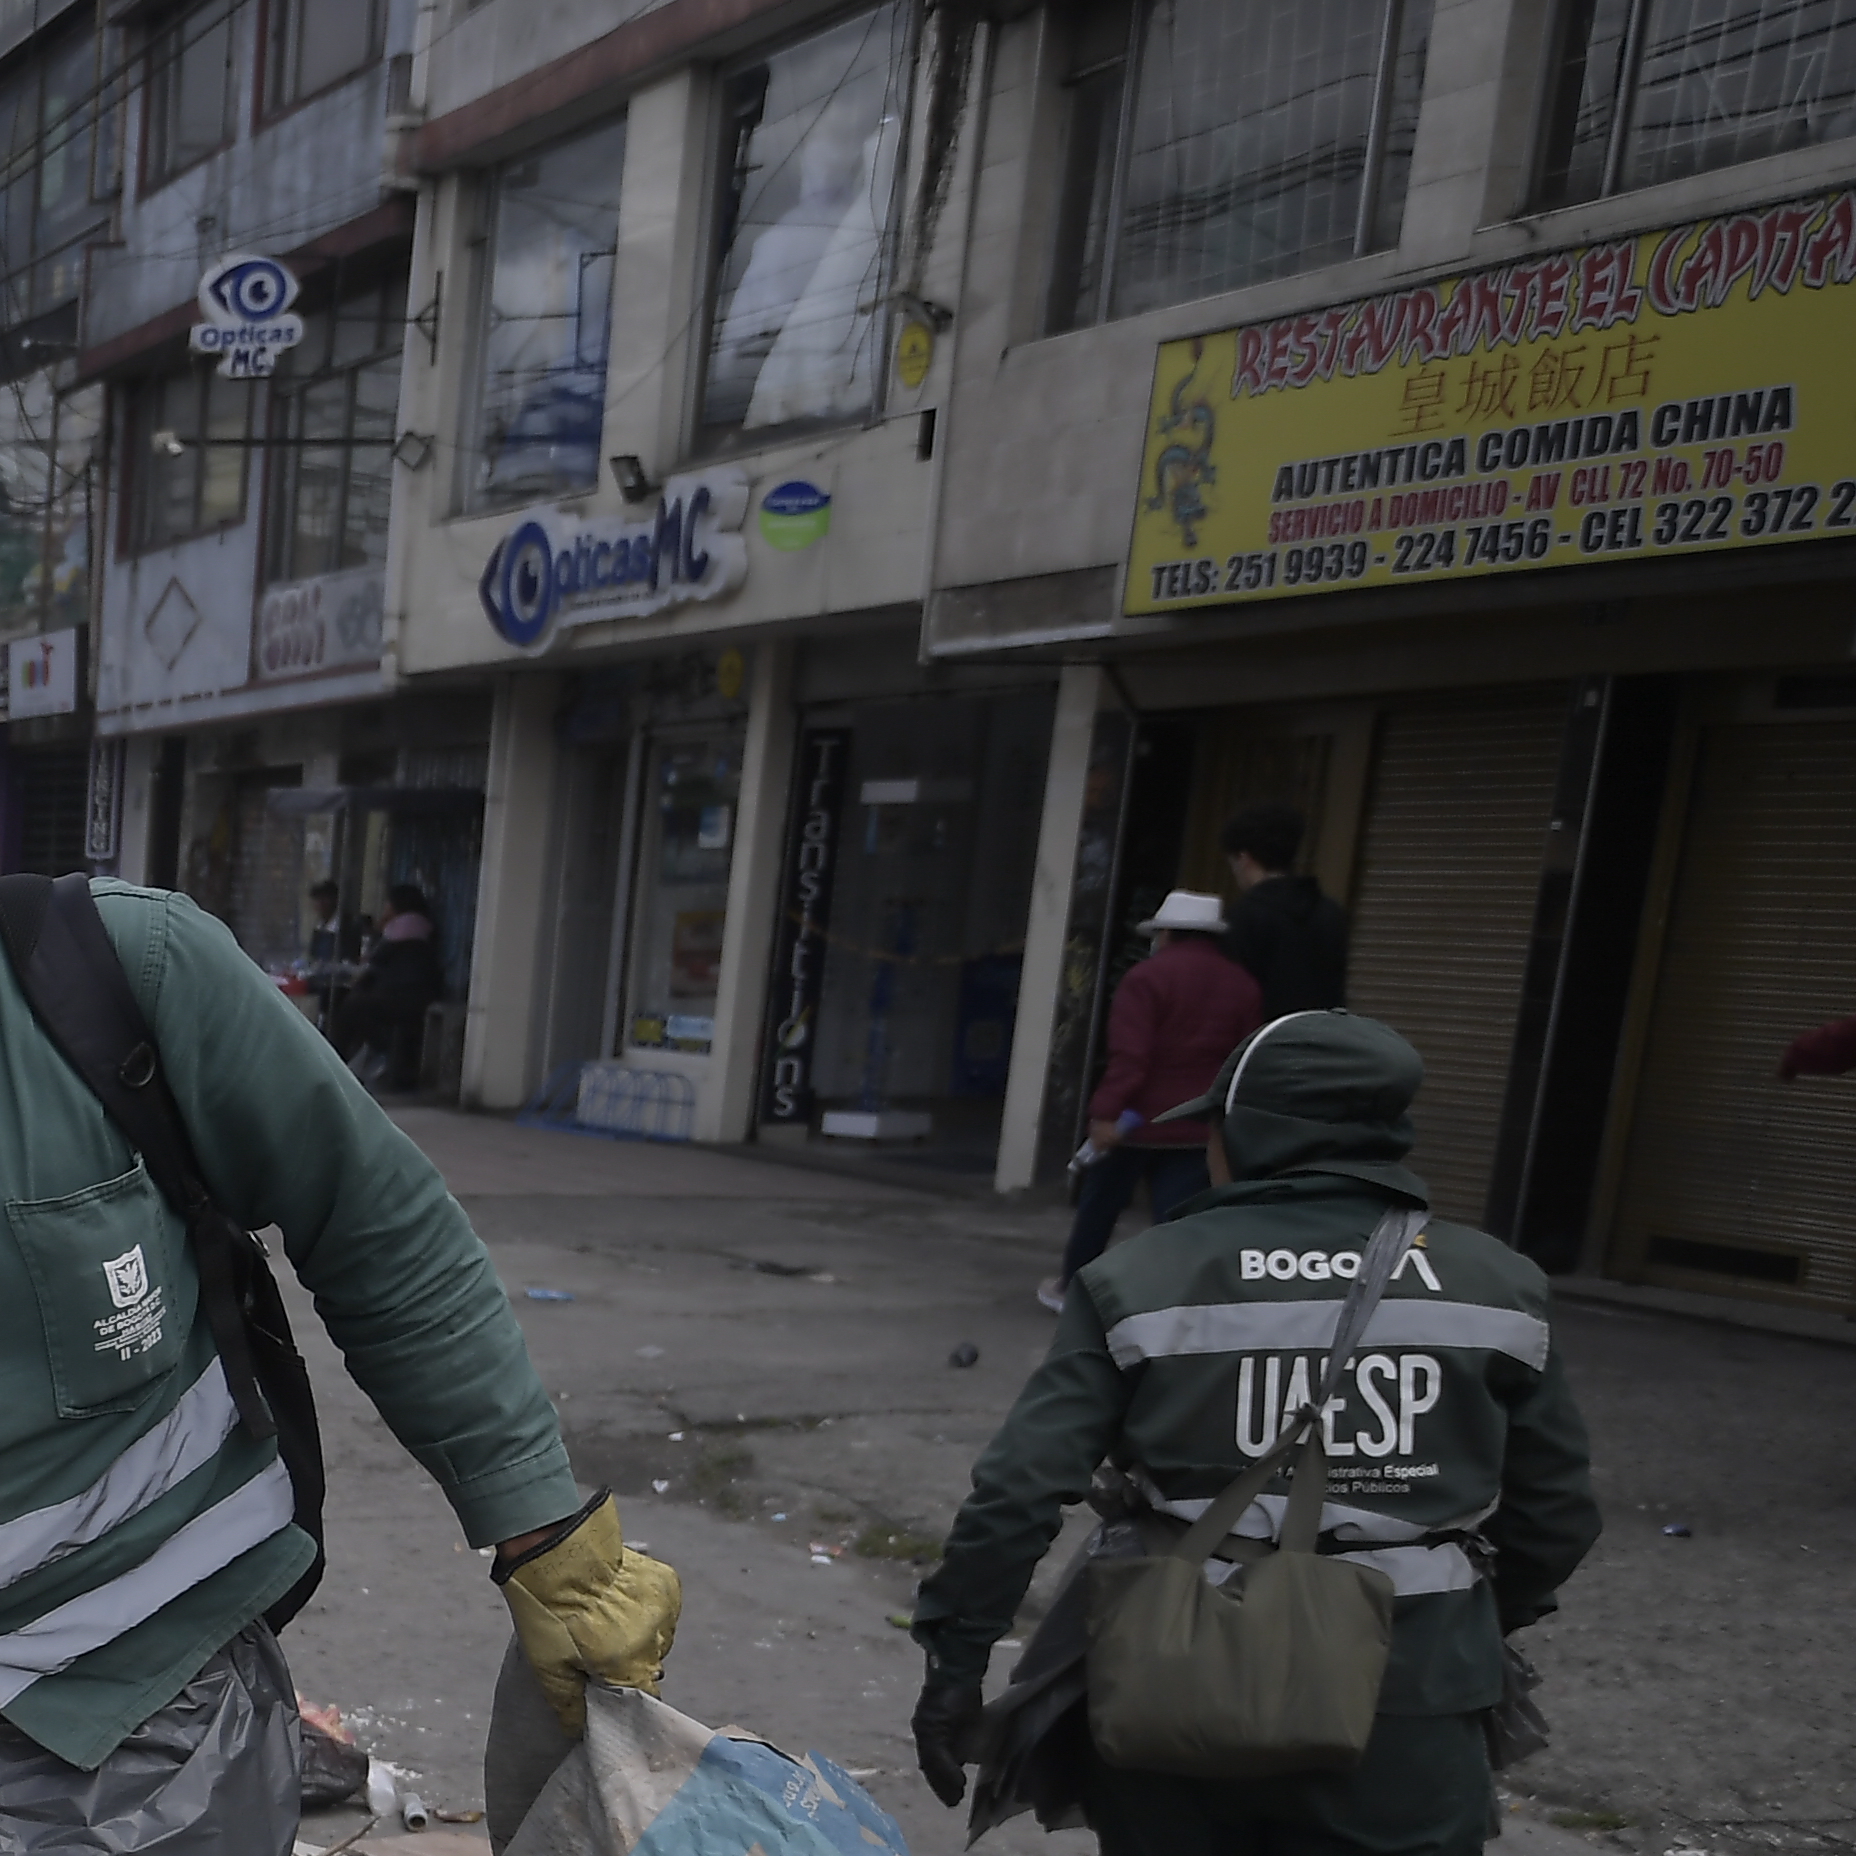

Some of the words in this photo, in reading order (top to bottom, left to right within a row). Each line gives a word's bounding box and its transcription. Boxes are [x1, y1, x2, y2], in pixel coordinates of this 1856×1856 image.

[199, 327, 294, 350] Opticas
[1230, 249, 1572, 398] RESTAURANTE
[1571, 239, 1641, 330] EL
[1646, 200, 1856, 316] CAPITA
[1388, 335, 1662, 437] 皇城飯店
[1269, 499, 1365, 544] SERVICIO
[1368, 497, 1383, 532] A
[1389, 478, 1509, 531] DOMICILIO
[1525, 471, 1562, 513] AV
[1568, 464, 1611, 508] CLL
[1617, 459, 1648, 501] 72
[1651, 455, 1692, 497] No.
[1700, 440, 1785, 491] 70-50
[1271, 436, 1470, 503] AUTENTICA
[1475, 407, 1641, 473] COMIDA
[1650, 384, 1794, 448] CHINA
[1151, 559, 1219, 601] TELS:
[1224, 552, 1278, 594] 251
[1283, 539, 1369, 588] 9939
[1391, 529, 1457, 575] 224
[1464, 517, 1551, 567] 7456
[1580, 506, 1643, 554] CEL
[1653, 495, 1733, 546] 322
[1740, 485, 1819, 538] 372
[1383, 1463, 1439, 1480] Especial
